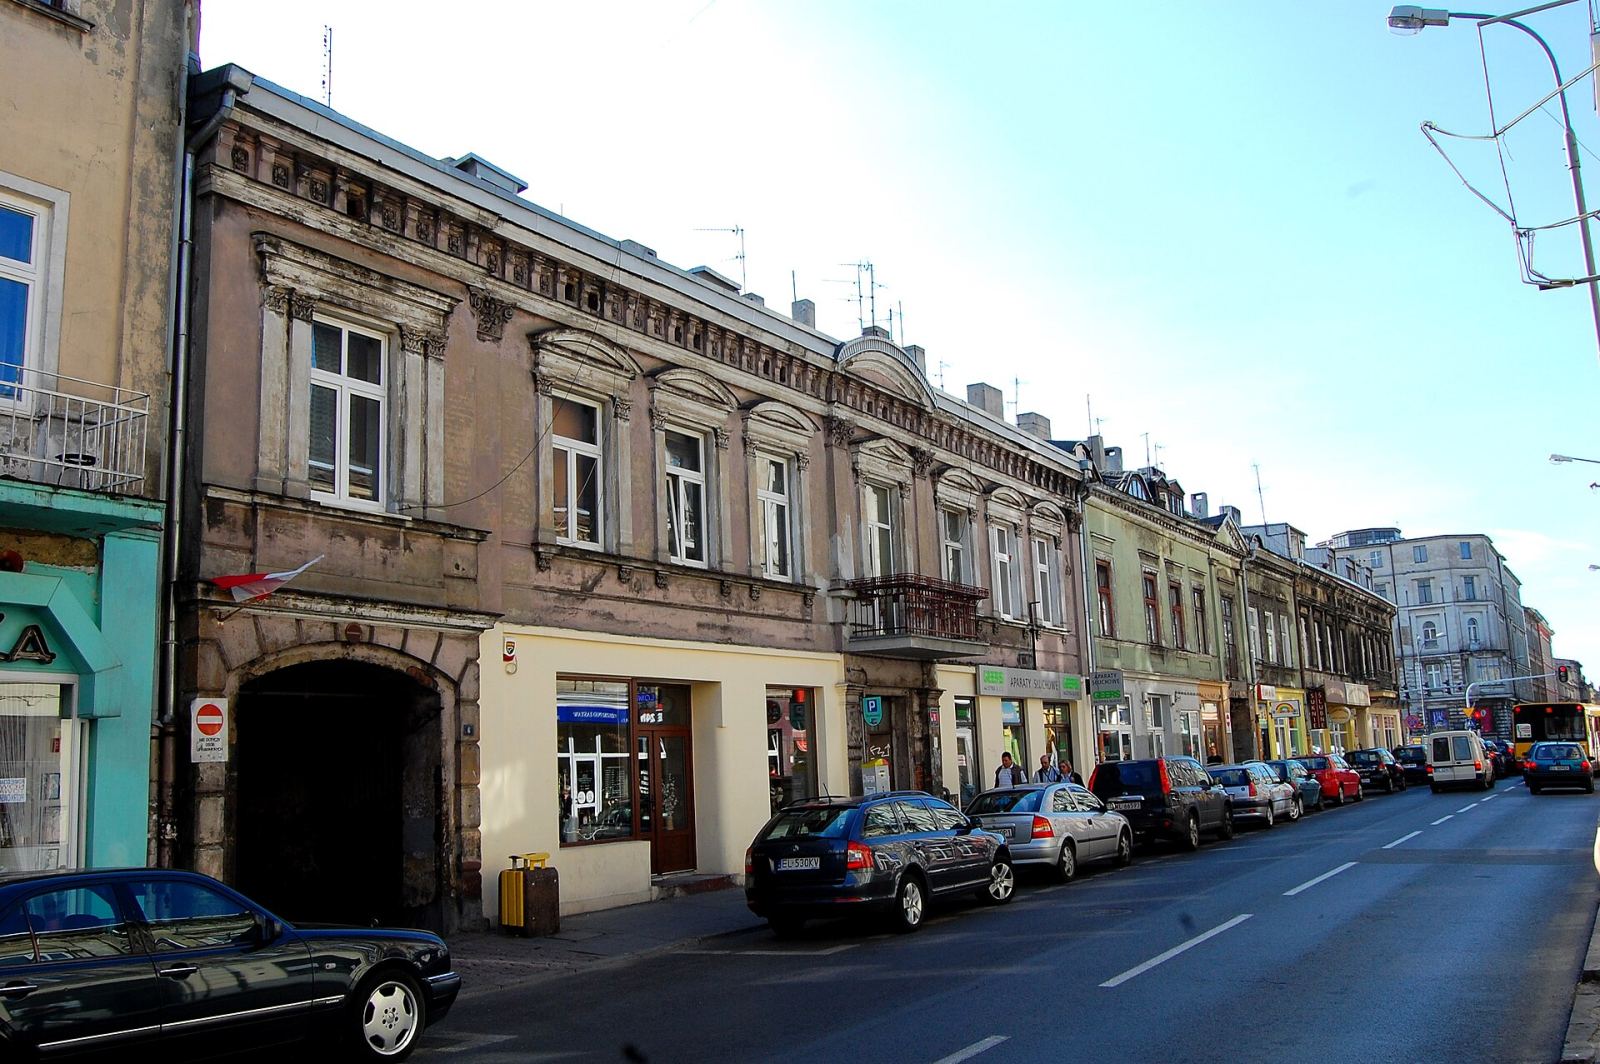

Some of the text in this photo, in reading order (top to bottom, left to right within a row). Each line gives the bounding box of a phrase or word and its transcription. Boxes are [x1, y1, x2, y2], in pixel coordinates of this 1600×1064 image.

[1010, 677, 1031, 688] APARATY
[868, 700, 876, 712] P
[1310, 693, 1318, 729] SUKNIE
[782, 858, 819, 868] EL 530KV
